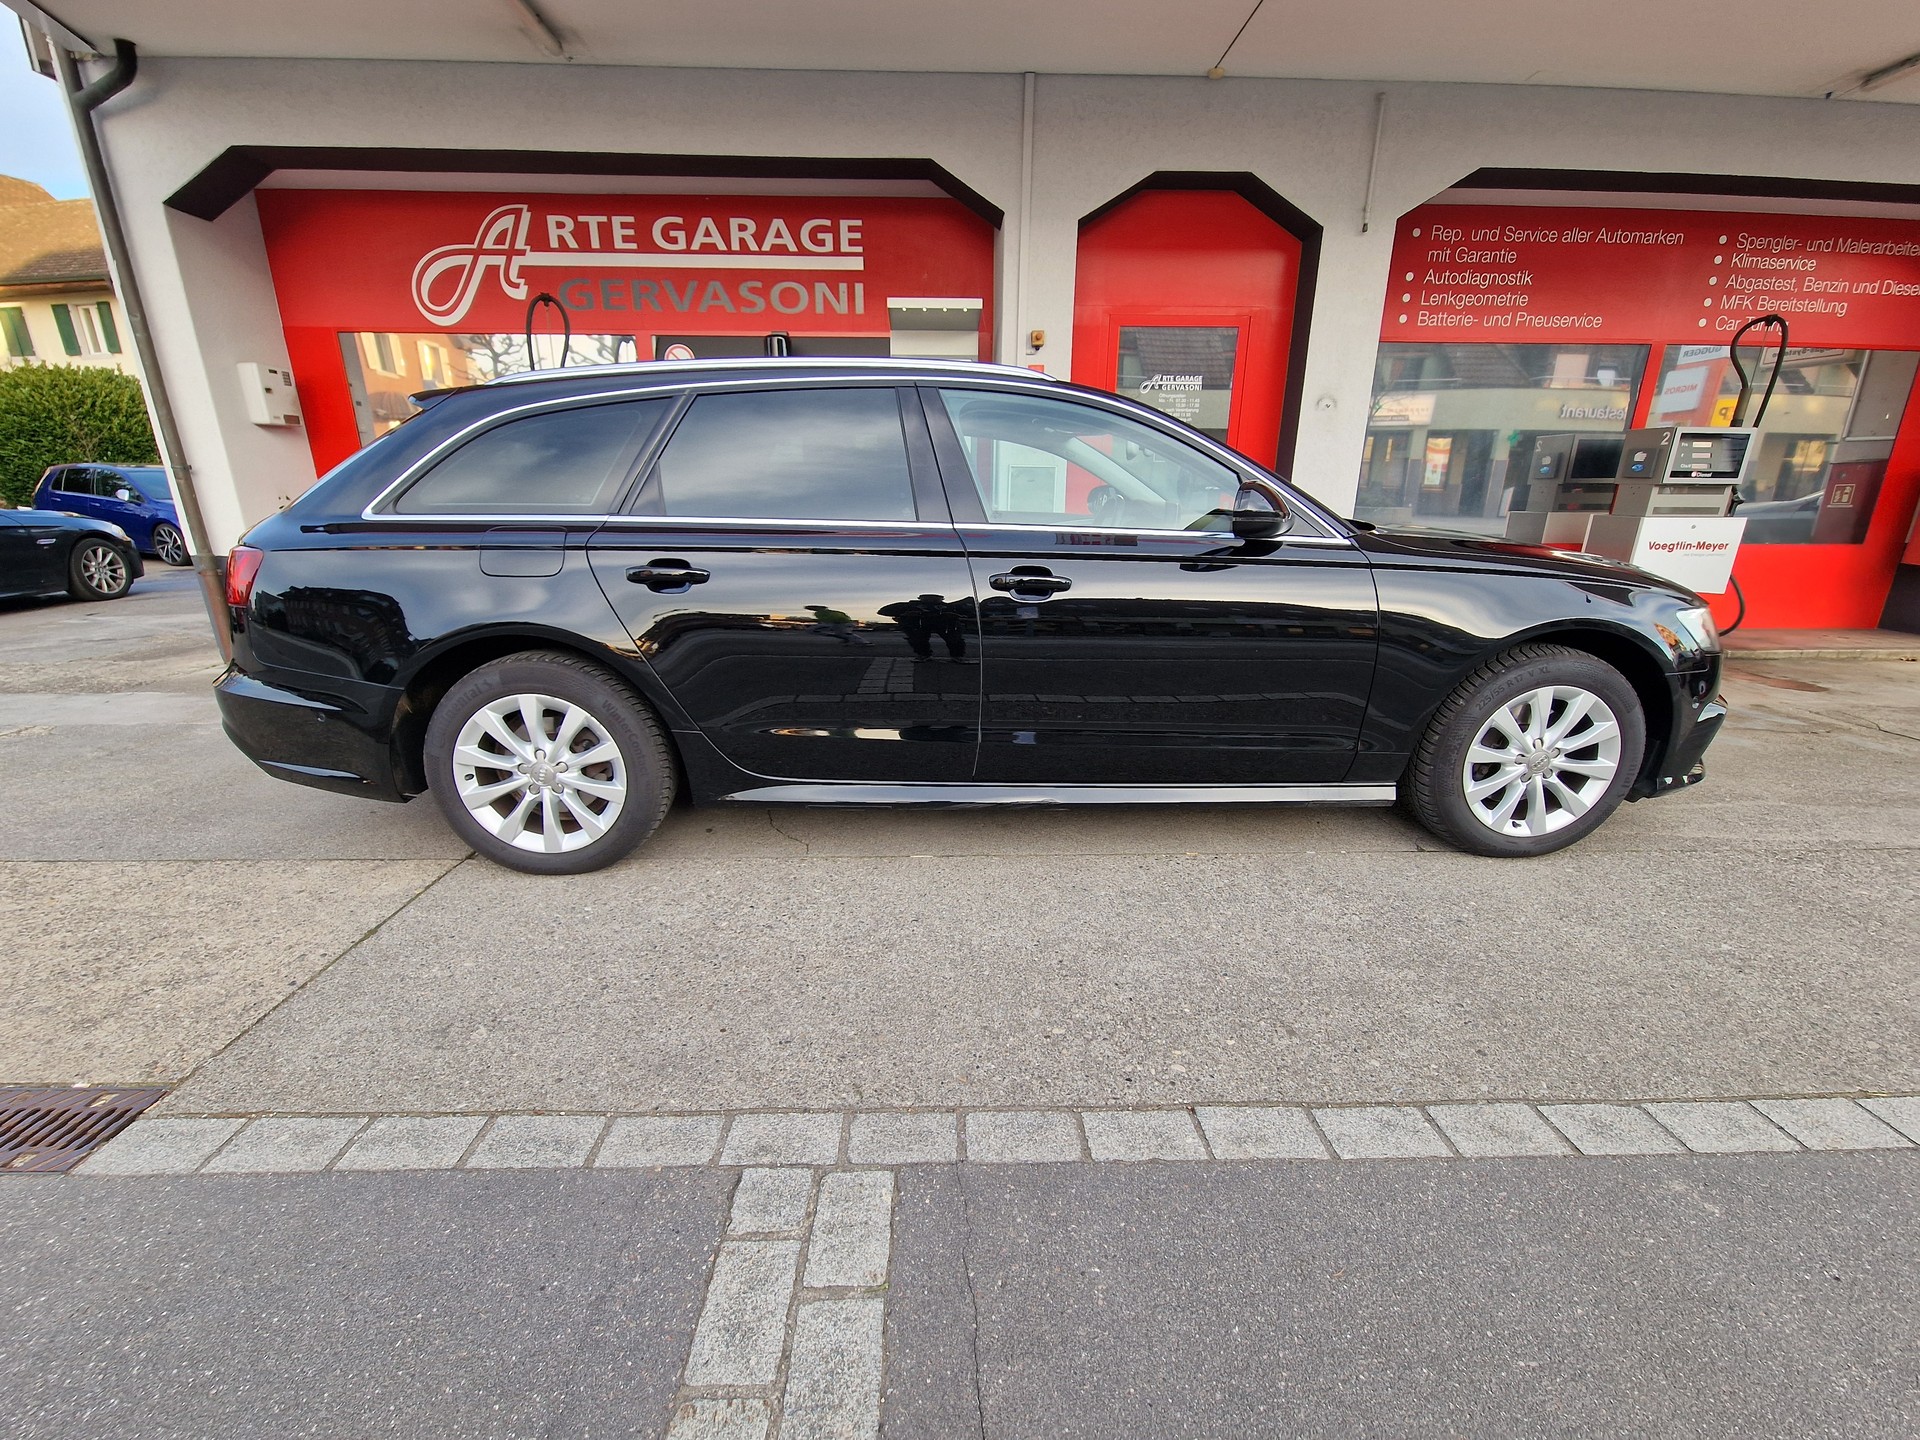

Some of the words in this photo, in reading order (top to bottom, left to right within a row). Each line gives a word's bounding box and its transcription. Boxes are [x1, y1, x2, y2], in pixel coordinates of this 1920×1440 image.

[651, 216, 864, 253] GARAGE
[1431, 224, 1465, 244] Rep.
[1471, 226, 1500, 242] und
[1503, 225, 1558, 243] Service
[1561, 227, 1593, 243] aller
[1595, 227, 1684, 245] Automarken
[1736, 232, 1803, 254] Spengler-
[1806, 238, 1834, 253] und
[1836, 238, 1920, 257] Malerarbeite
[1427, 247, 1452, 263] mit
[1455, 246, 1518, 264] Garantie
[1730, 252, 1817, 272] Klimaservice
[1423, 268, 1534, 289] Autodiagnostik
[1725, 274, 1799, 294] Abgastest,
[1803, 276, 1850, 293] Benzin
[1852, 280, 1881, 294] und
[1881, 280, 1920, 296] Diese
[558, 278, 865, 315] GERVASONI
[1420, 290, 1529, 310] Lenkgeometrie
[1720, 295, 1756, 311] MFK
[1757, 295, 1848, 318] Bereitstellung
[1417, 310, 1479, 327] Batterie-
[1483, 313, 1512, 328] und
[1515, 311, 1603, 329] Pneuservice
[1715, 315, 1742, 332] Car
[1660, 431, 1671, 446] 2
[1648, 541, 1730, 553] Voegtlin-Meyer
